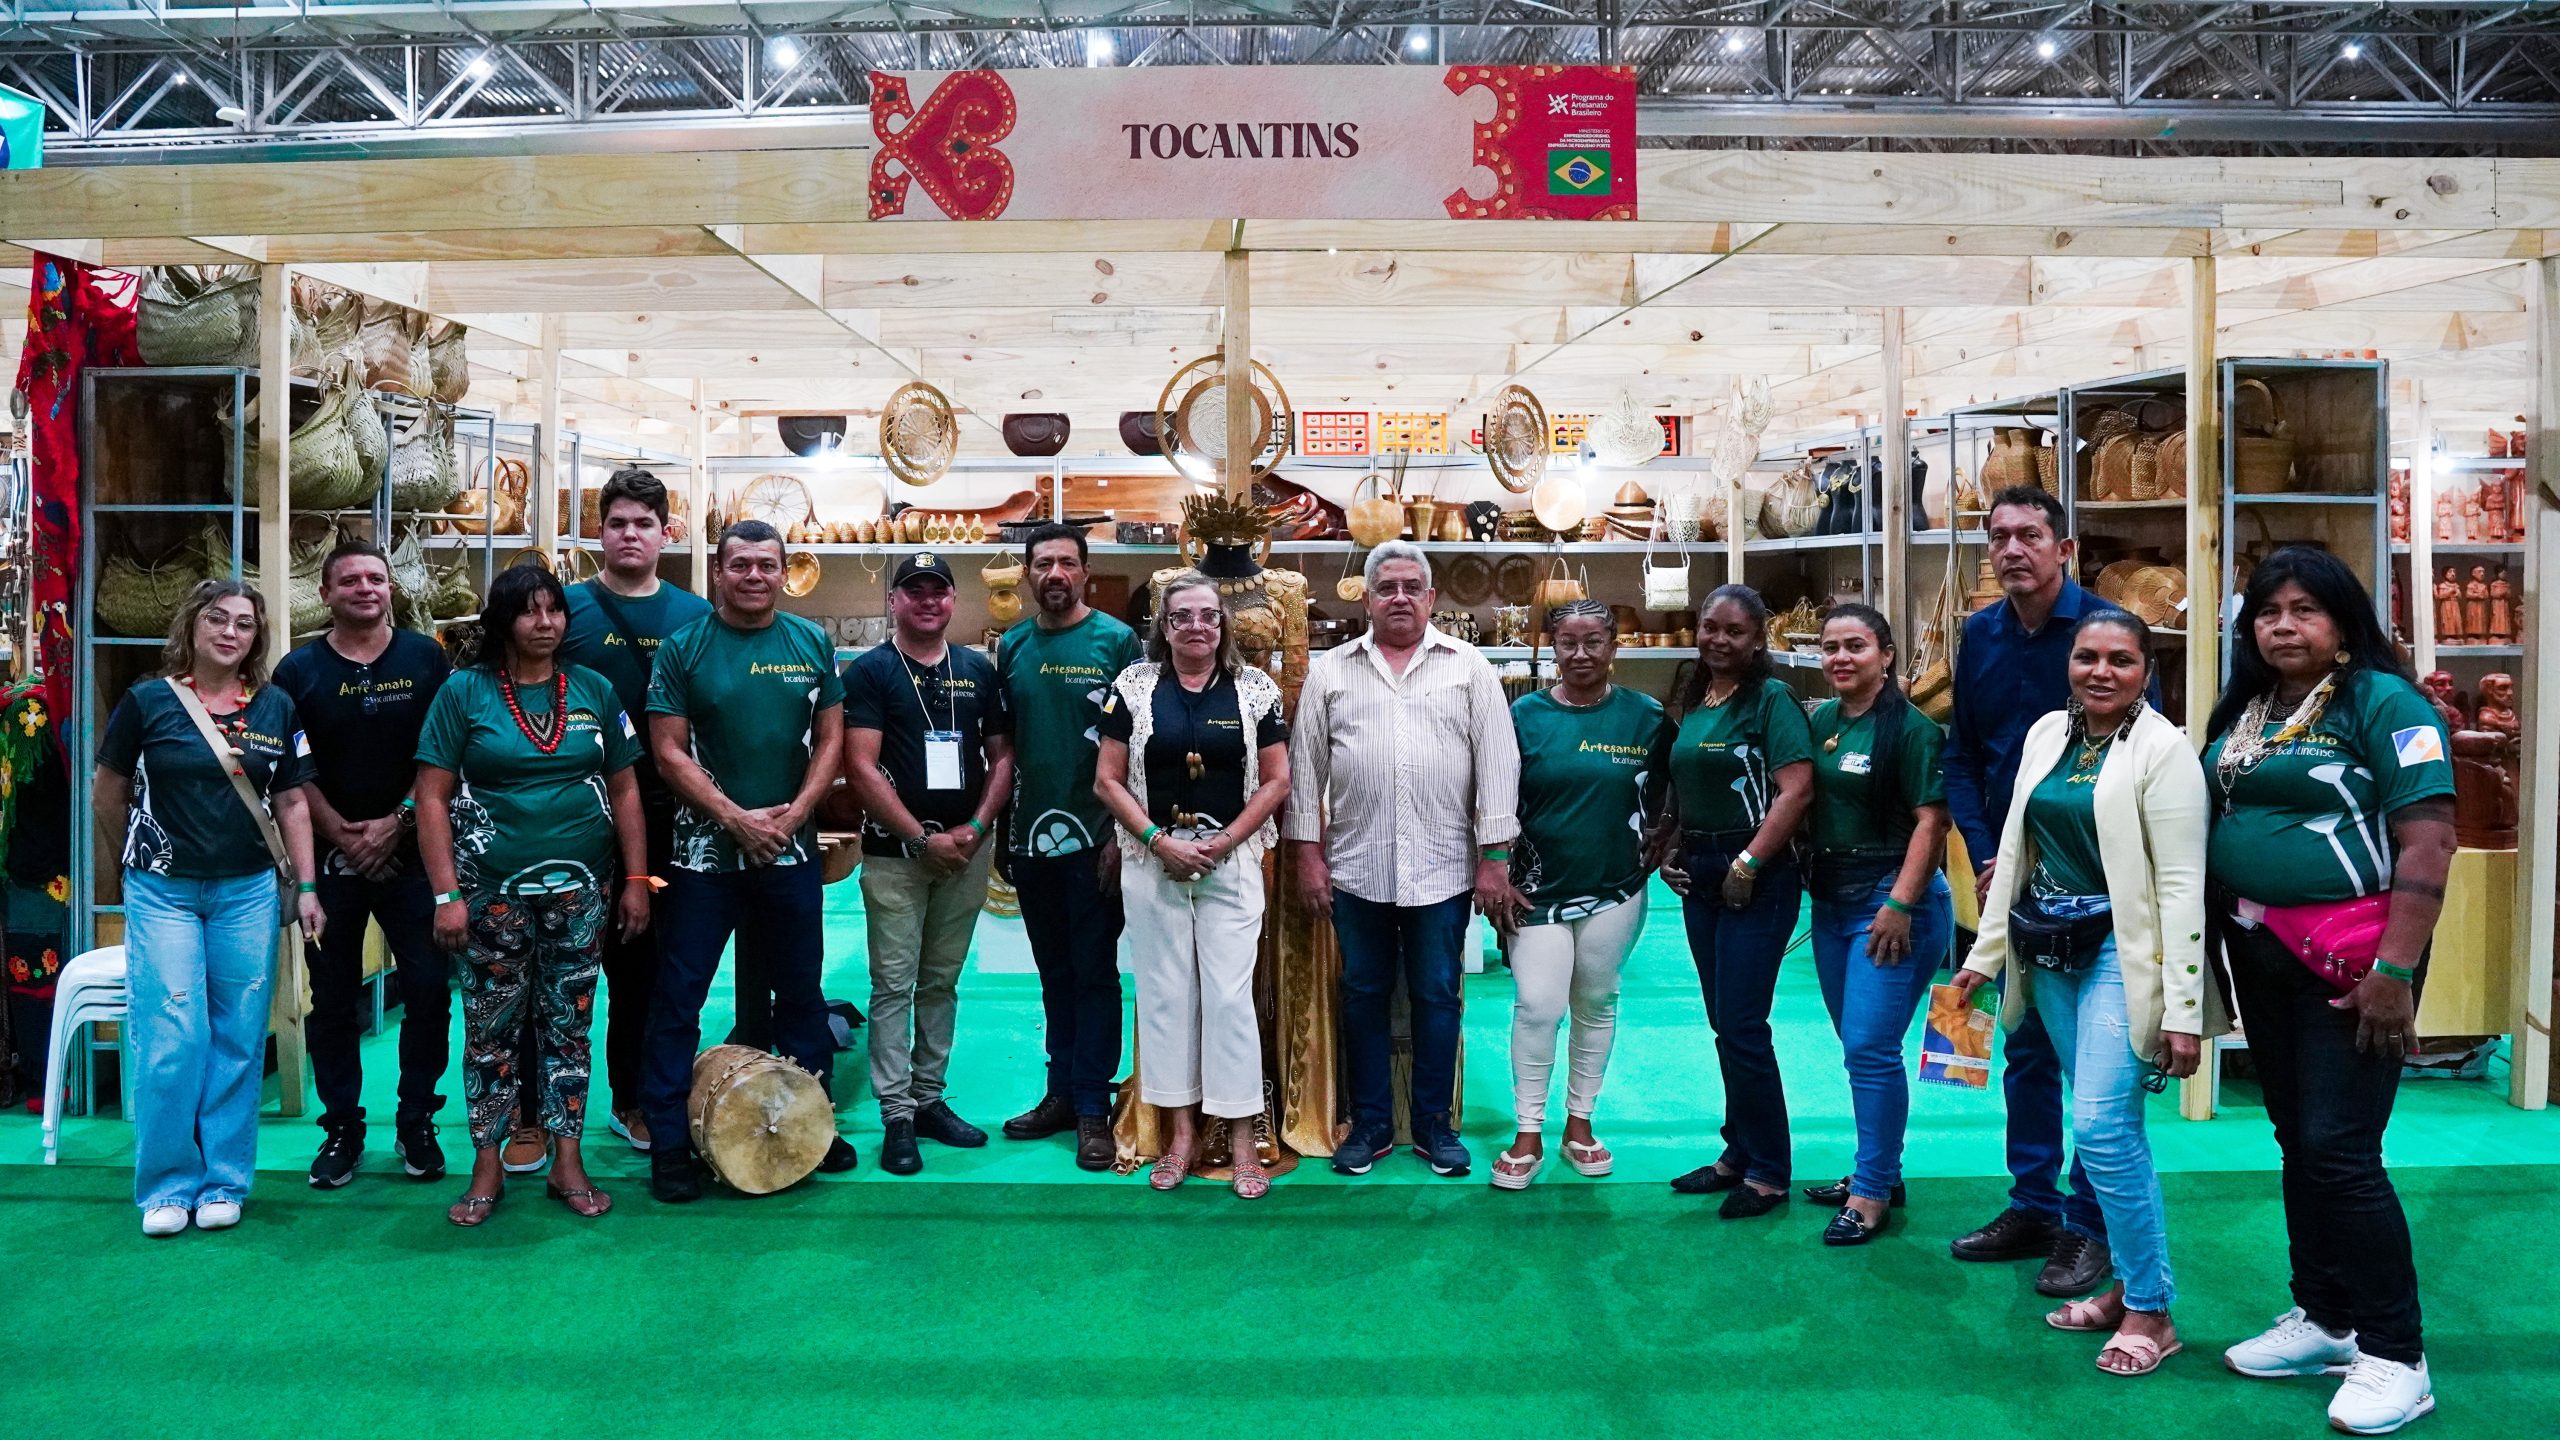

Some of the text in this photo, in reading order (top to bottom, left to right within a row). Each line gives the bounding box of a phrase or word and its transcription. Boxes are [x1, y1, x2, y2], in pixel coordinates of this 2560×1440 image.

[1571, 93, 1614, 103] Programa do
[1571, 108, 1602, 116] Brasileiro
[1122, 122, 1360, 159] TOCANTINS
[1040, 662, 1103, 676] Artesanato
[1579, 740, 1648, 756] Artesanato
